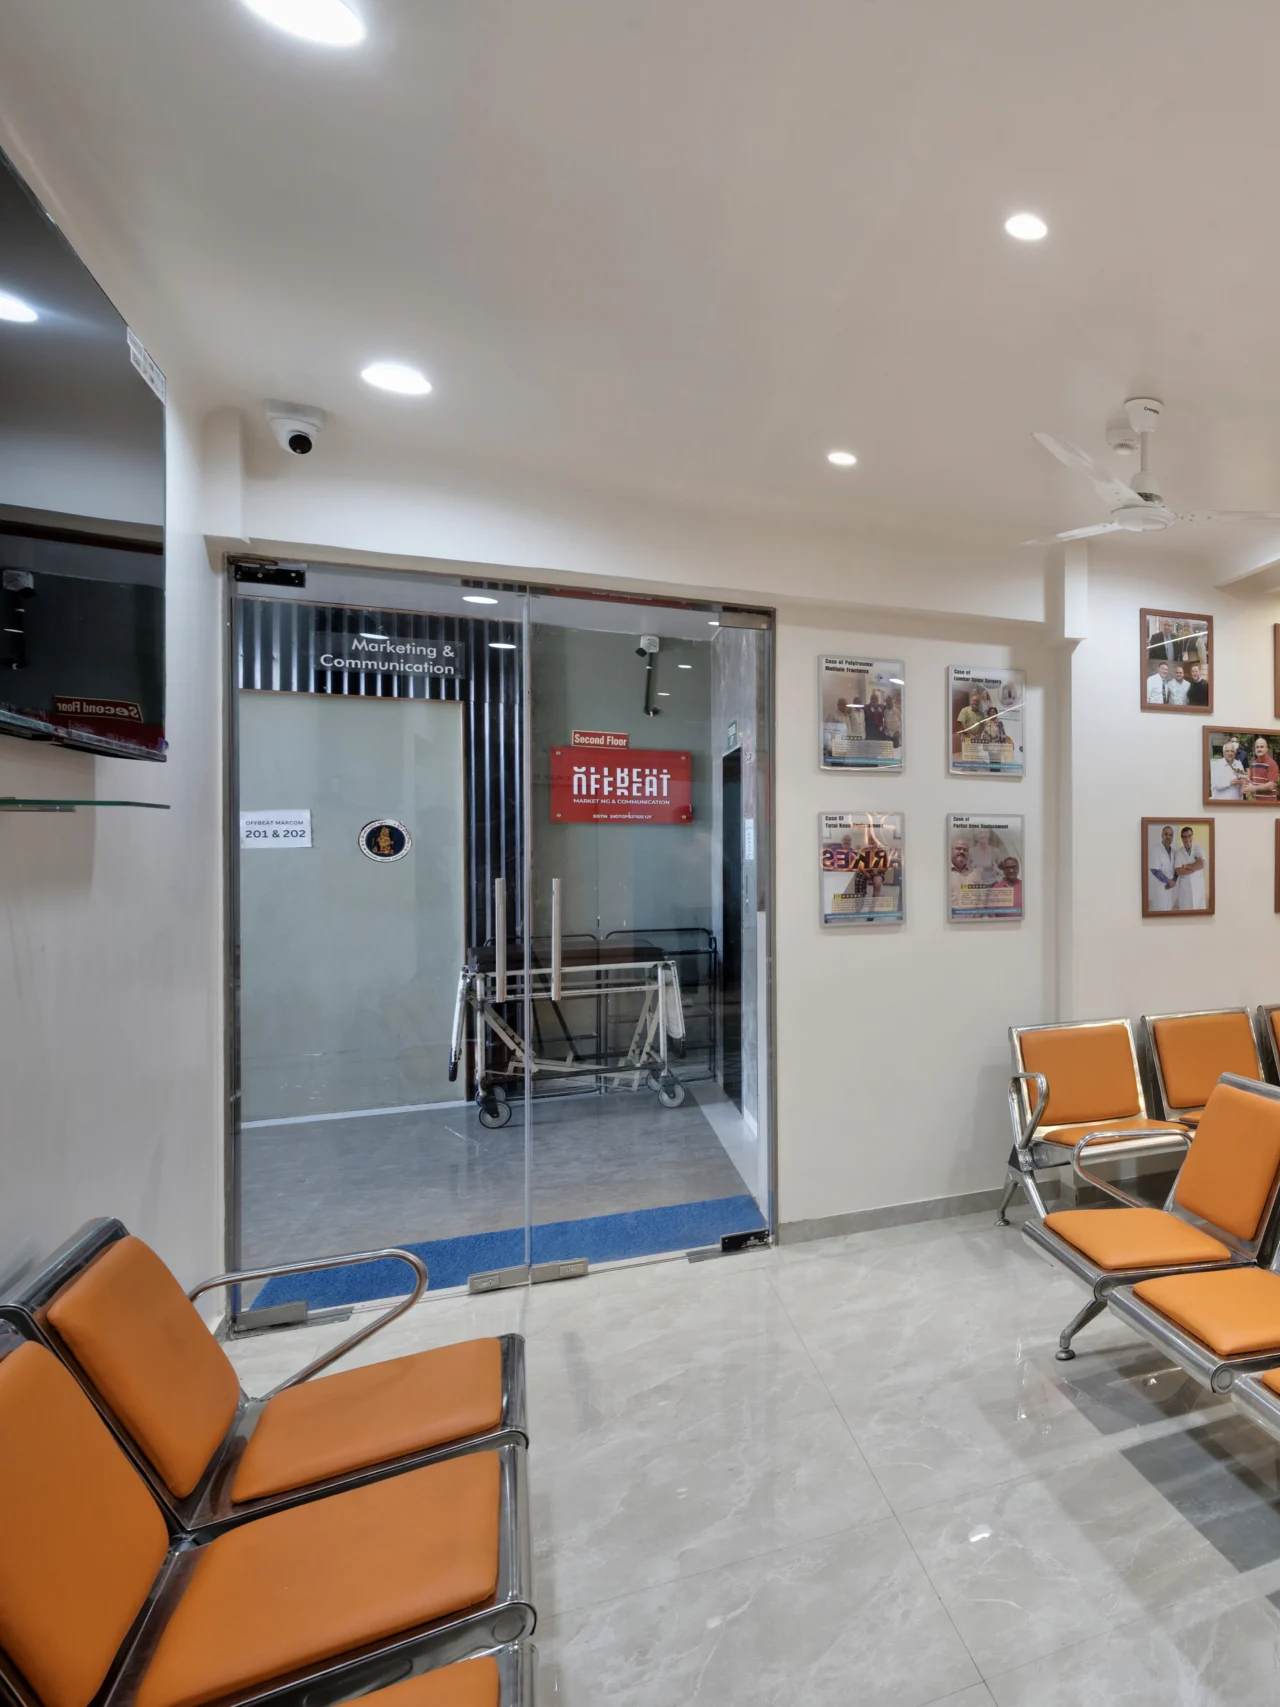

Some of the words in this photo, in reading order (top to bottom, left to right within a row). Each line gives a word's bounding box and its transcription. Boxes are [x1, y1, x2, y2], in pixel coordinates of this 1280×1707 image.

[351, 638, 437, 659] Marketing
[442, 645, 455, 657] &
[320, 653, 455, 675] Communication
[574, 733, 604, 745] Second
[606, 735, 627, 746] Floor
[573, 766, 671, 797] OFFBEAT
[245, 829, 268, 838] 201
[271, 829, 280, 838] &
[283, 829, 306, 838] 202
